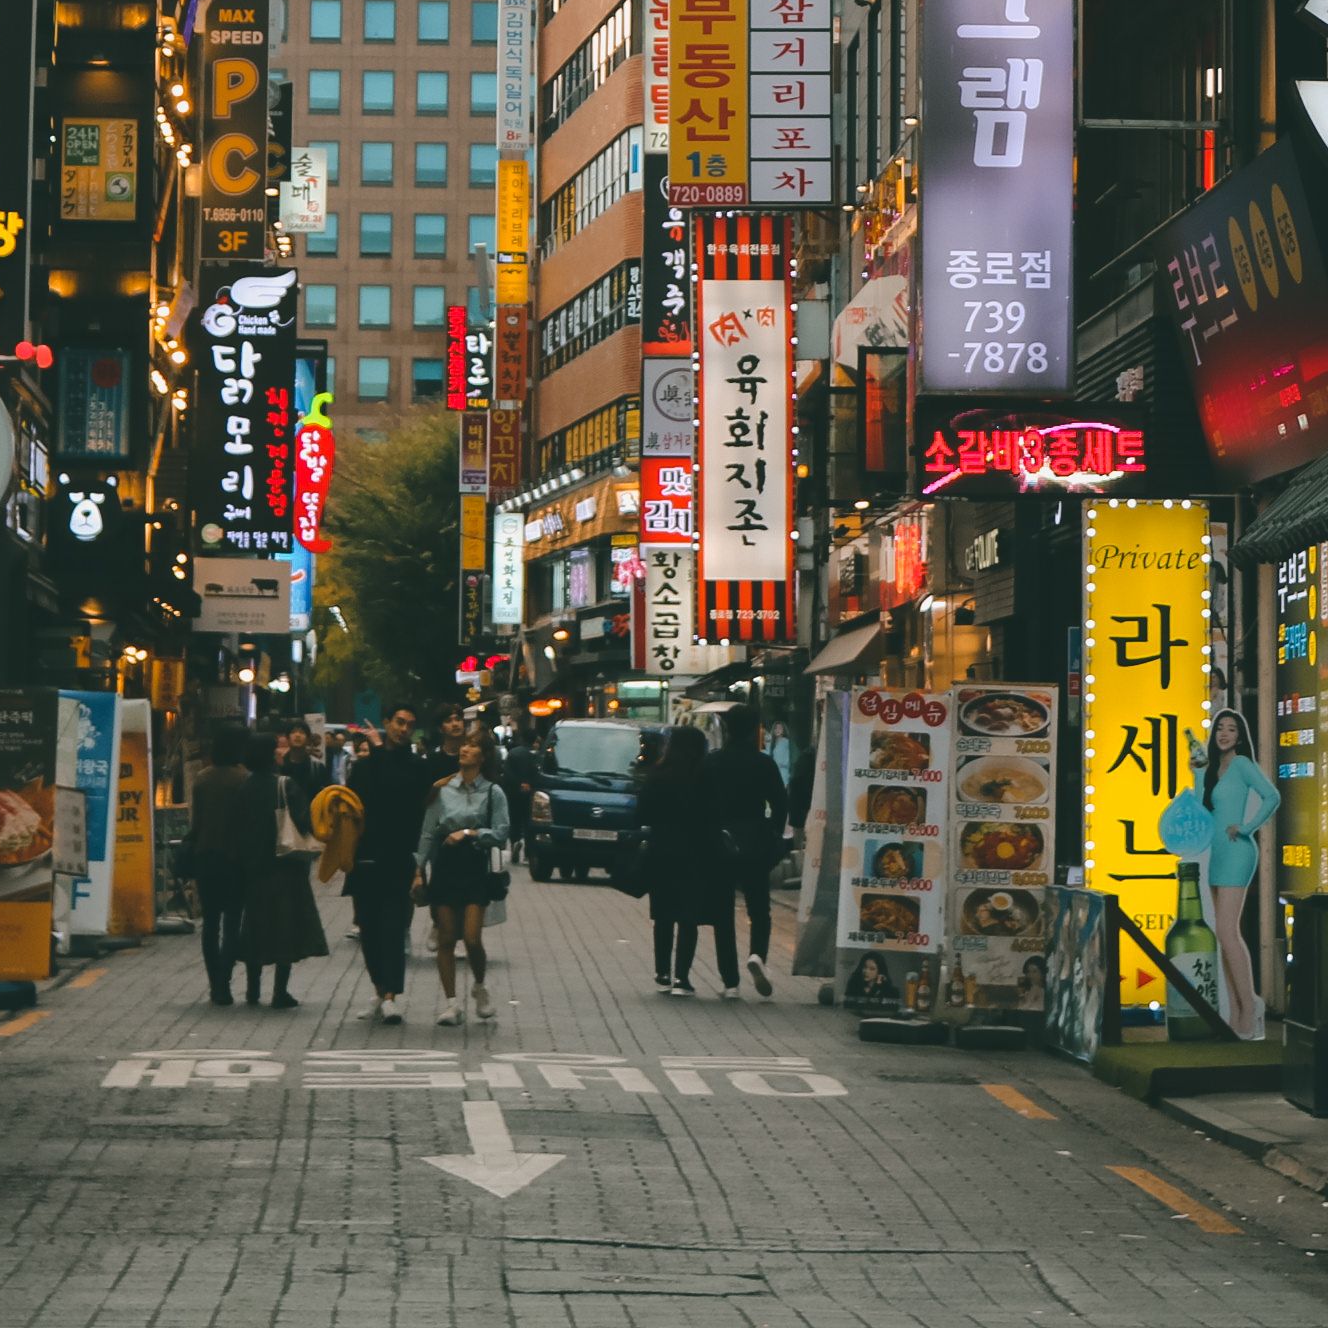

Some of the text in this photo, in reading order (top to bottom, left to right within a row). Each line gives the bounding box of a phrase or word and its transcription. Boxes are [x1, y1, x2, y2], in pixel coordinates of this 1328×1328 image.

[219, 9, 255, 22] MAX
[210, 31, 264, 45] SPEED
[68, 128, 99, 140] 24H
[208, 57, 261, 196] PC
[506, 130, 522, 140] 8F
[66, 140, 98, 149] OPEN
[686, 151, 727, 177] 1층
[673, 184, 743, 204] 720-0889
[218, 231, 249, 253] 3F
[946, 250, 1052, 290] 종로점
[963, 302, 1025, 333] 739
[948, 343, 1049, 372] -7878
[723, 354, 769, 546] 육회지존
[925, 429, 1147, 476] 소갈비3종세트
[1095, 543, 1201, 571] Private
[652, 551, 682, 671] 황소곱창
[1107, 603, 1189, 881] 라세느
[1193, 959, 1211, 982] 참
